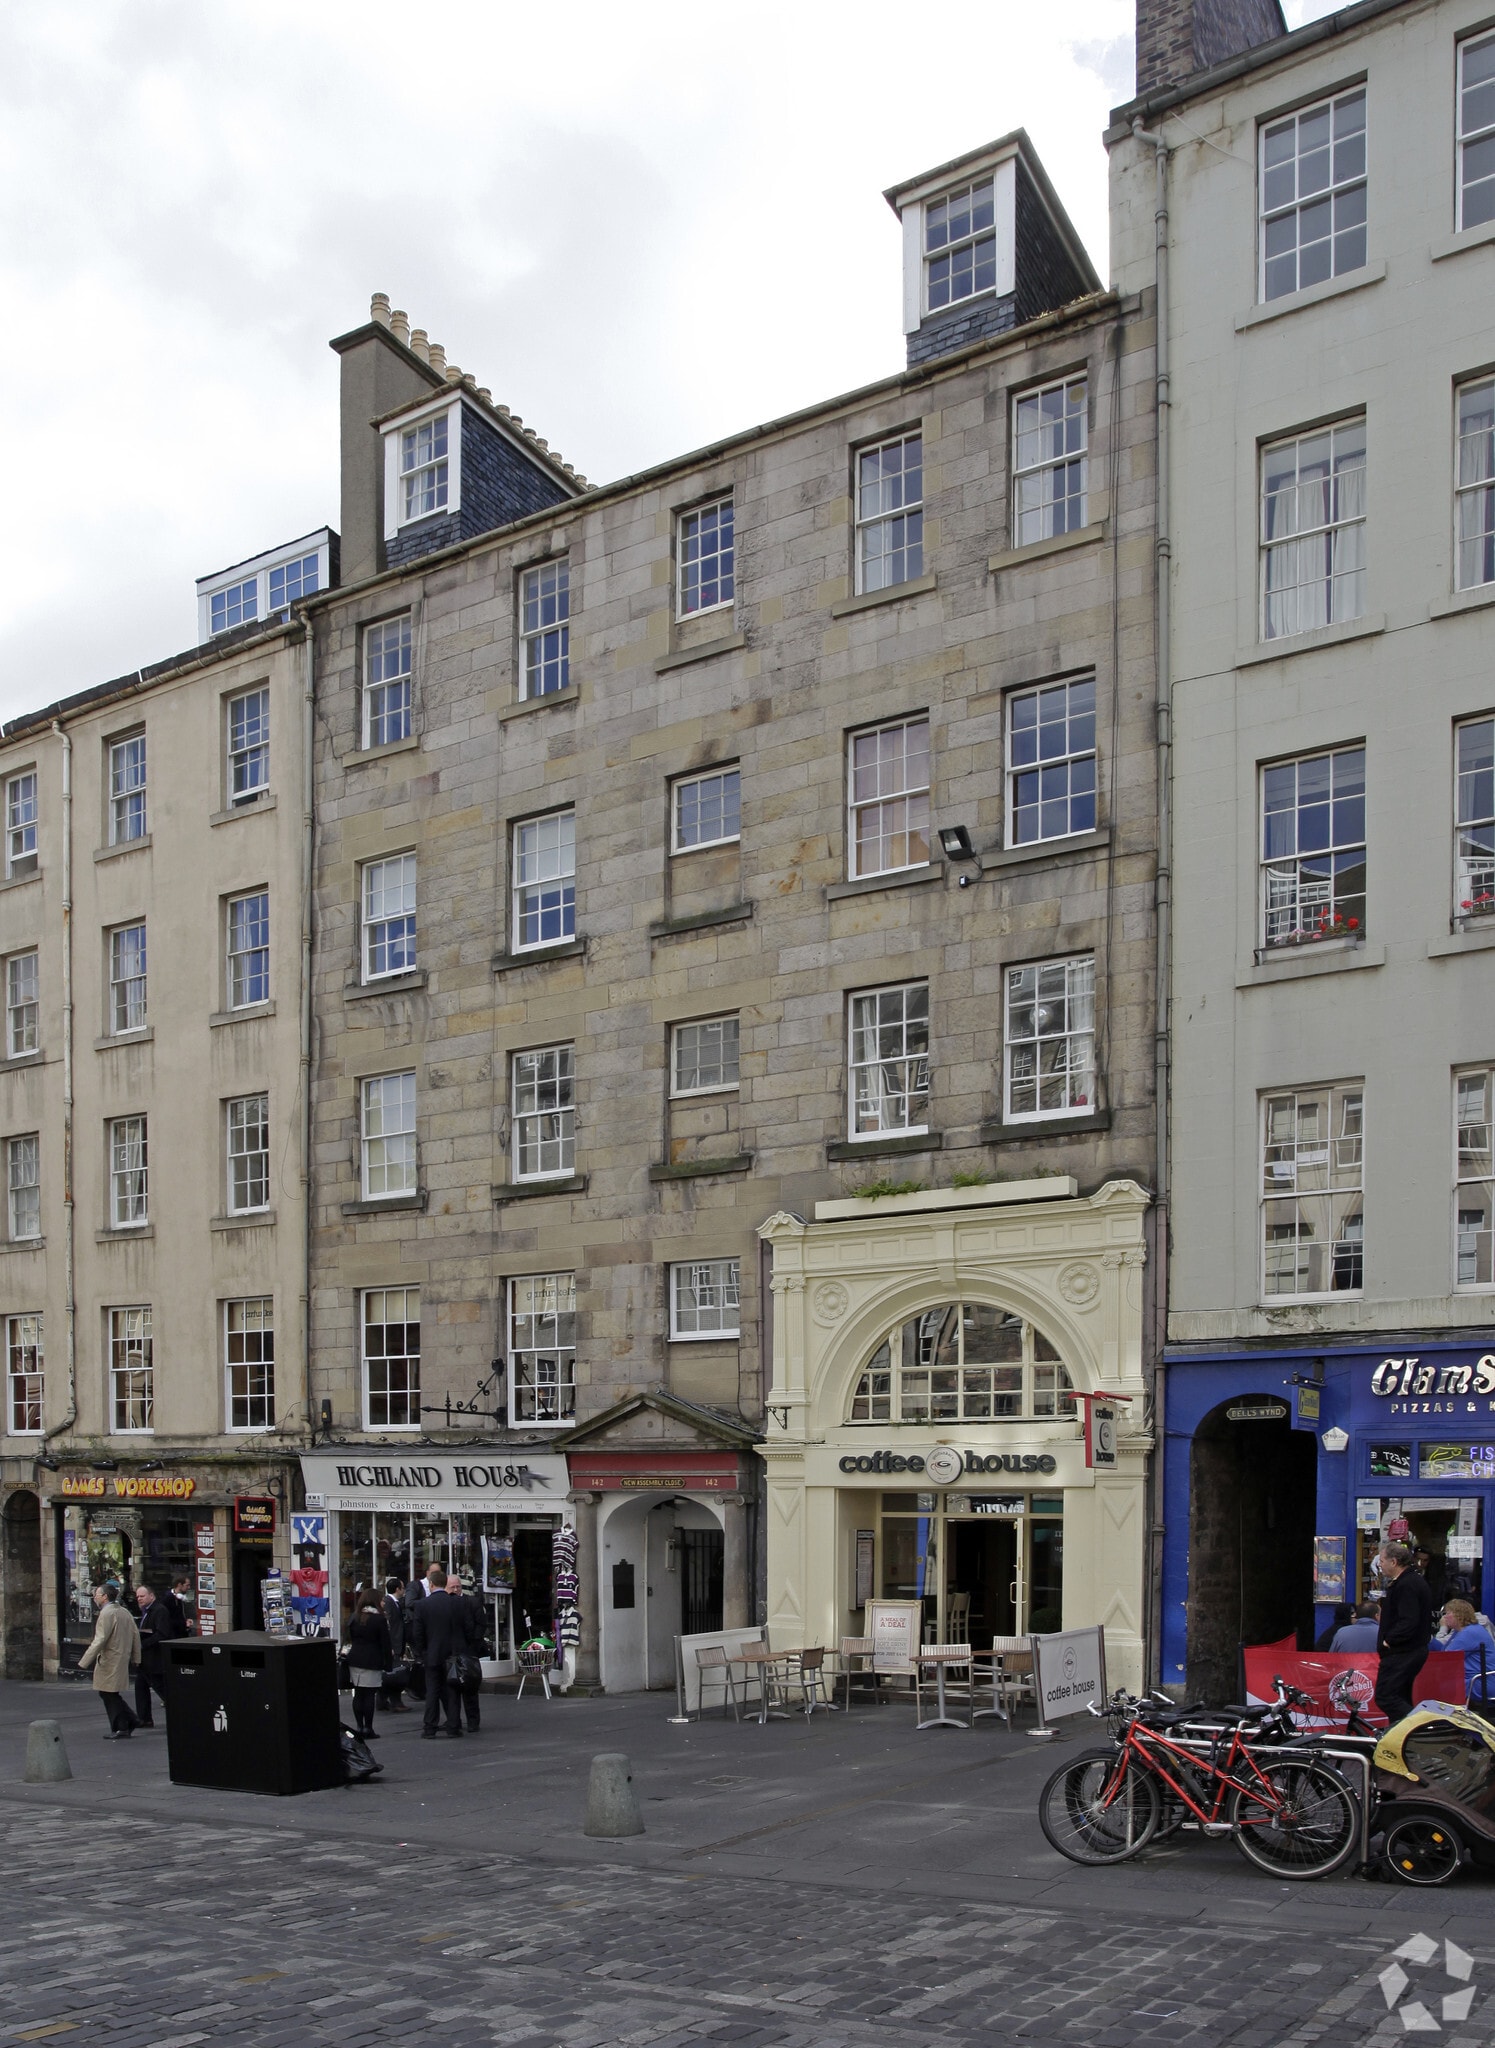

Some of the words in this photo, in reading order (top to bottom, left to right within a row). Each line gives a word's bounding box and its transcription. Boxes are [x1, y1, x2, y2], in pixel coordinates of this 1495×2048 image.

[1231, 1409, 1257, 1417] BELL'S
[1260, 1408, 1281, 1416] WYND
[1391, 1402, 1454, 1413] PIZZAS
[1466, 1402, 1477, 1412] &
[838, 1450, 925, 1474] coffee
[964, 1450, 1056, 1473] house
[336, 1466, 442, 1488] HIGHLAND
[453, 1465, 529, 1488] HOUSE
[62, 1477, 105, 1496] GAMES
[113, 1477, 195, 1499] WORKSHOP
[246, 1506, 266, 1514] GAMES
[340, 1500, 378, 1509] Johnstons
[390, 1501, 435, 1510] Cashmere
[197, 1536, 214, 1547] HERE
[181, 1667, 195, 1675] Litter
[240, 1670, 256, 1678] Litter
[1047, 1685, 1071, 1702] coffee
[1072, 1680, 1095, 1696] house
